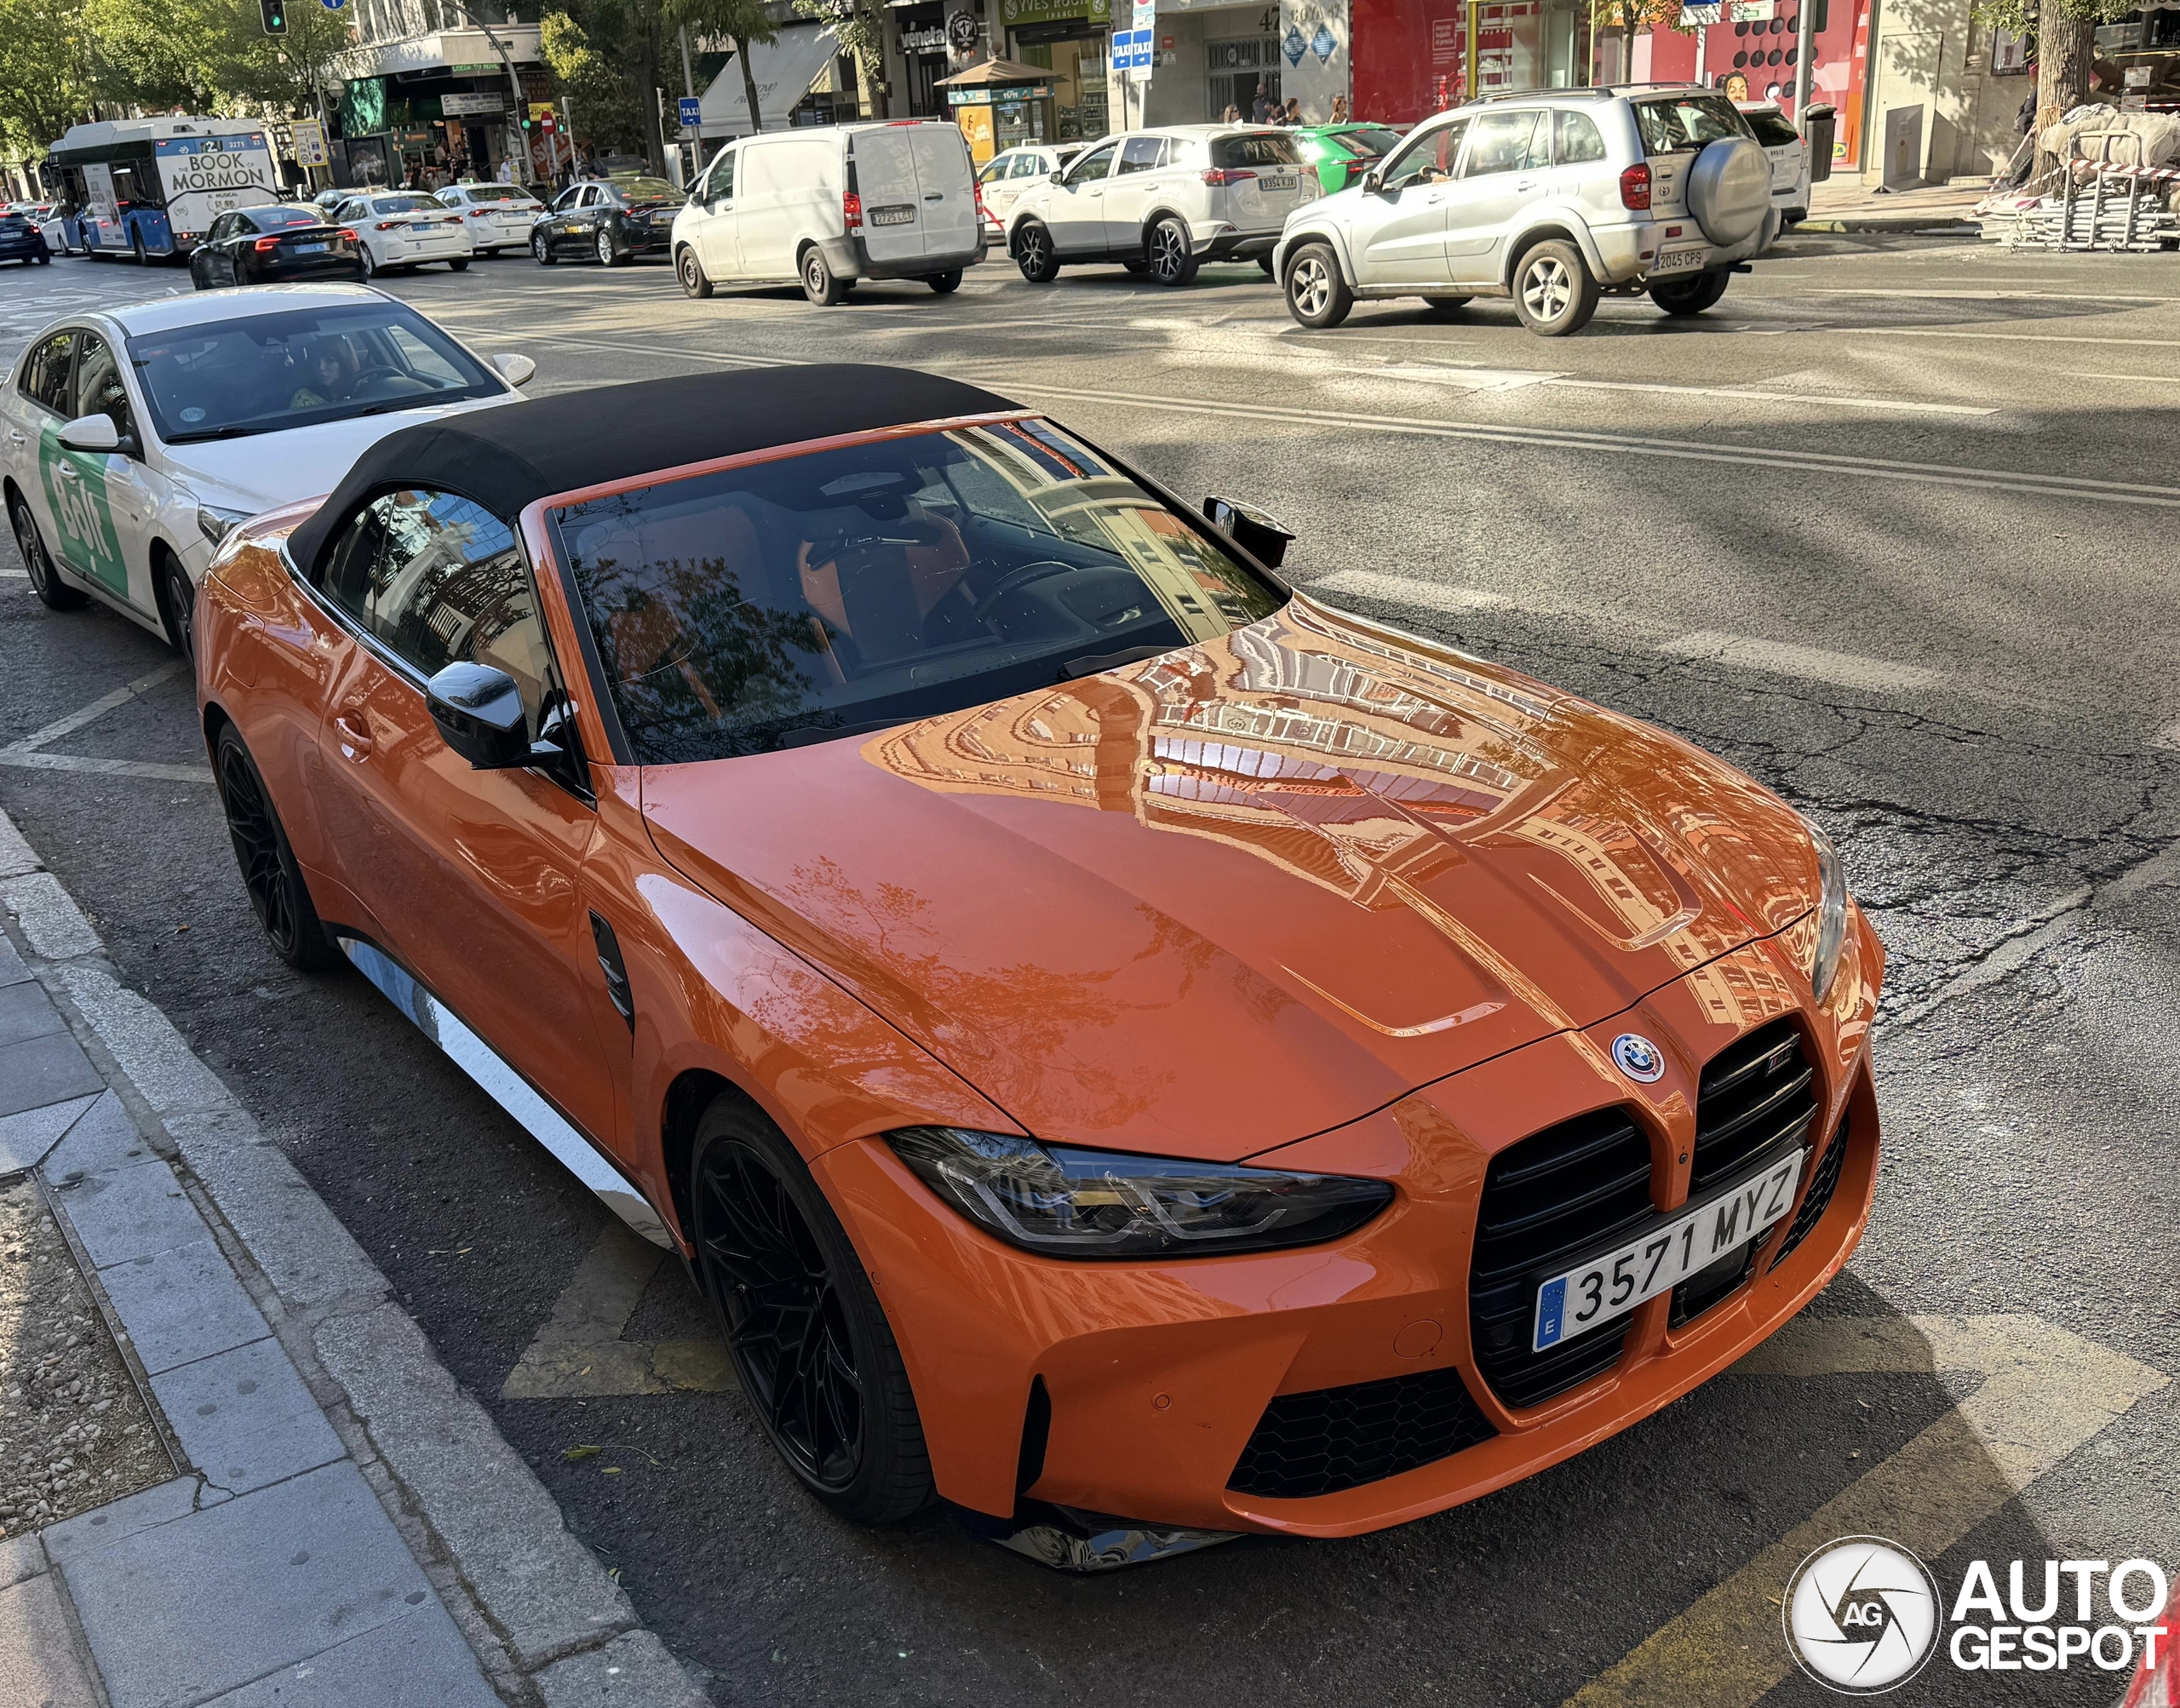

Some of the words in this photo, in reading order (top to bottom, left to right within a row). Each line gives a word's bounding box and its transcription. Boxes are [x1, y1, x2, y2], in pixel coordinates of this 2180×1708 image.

[1046, 9, 1077, 20] FRANCE
[1290, 6, 1324, 22] GOYA
[900, 21, 946, 49] véneta
[1114, 44, 1131, 58] TAXI
[1133, 41, 1151, 55] TAXI
[681, 107, 700, 117] TAXI
[189, 152, 244, 171] BOOK
[173, 169, 265, 190] MORMON
[1264, 178, 1280, 188] 9354
[877, 215, 897, 223] 2725
[1661, 254, 1683, 268] 2045
[1684, 251, 1702, 265] CPS
[49, 460, 112, 563] Bolt
[1575, 1223, 1695, 1322] 3571
[1712, 1164, 1793, 1254] MYZ
[1545, 1319, 1555, 1335] E
